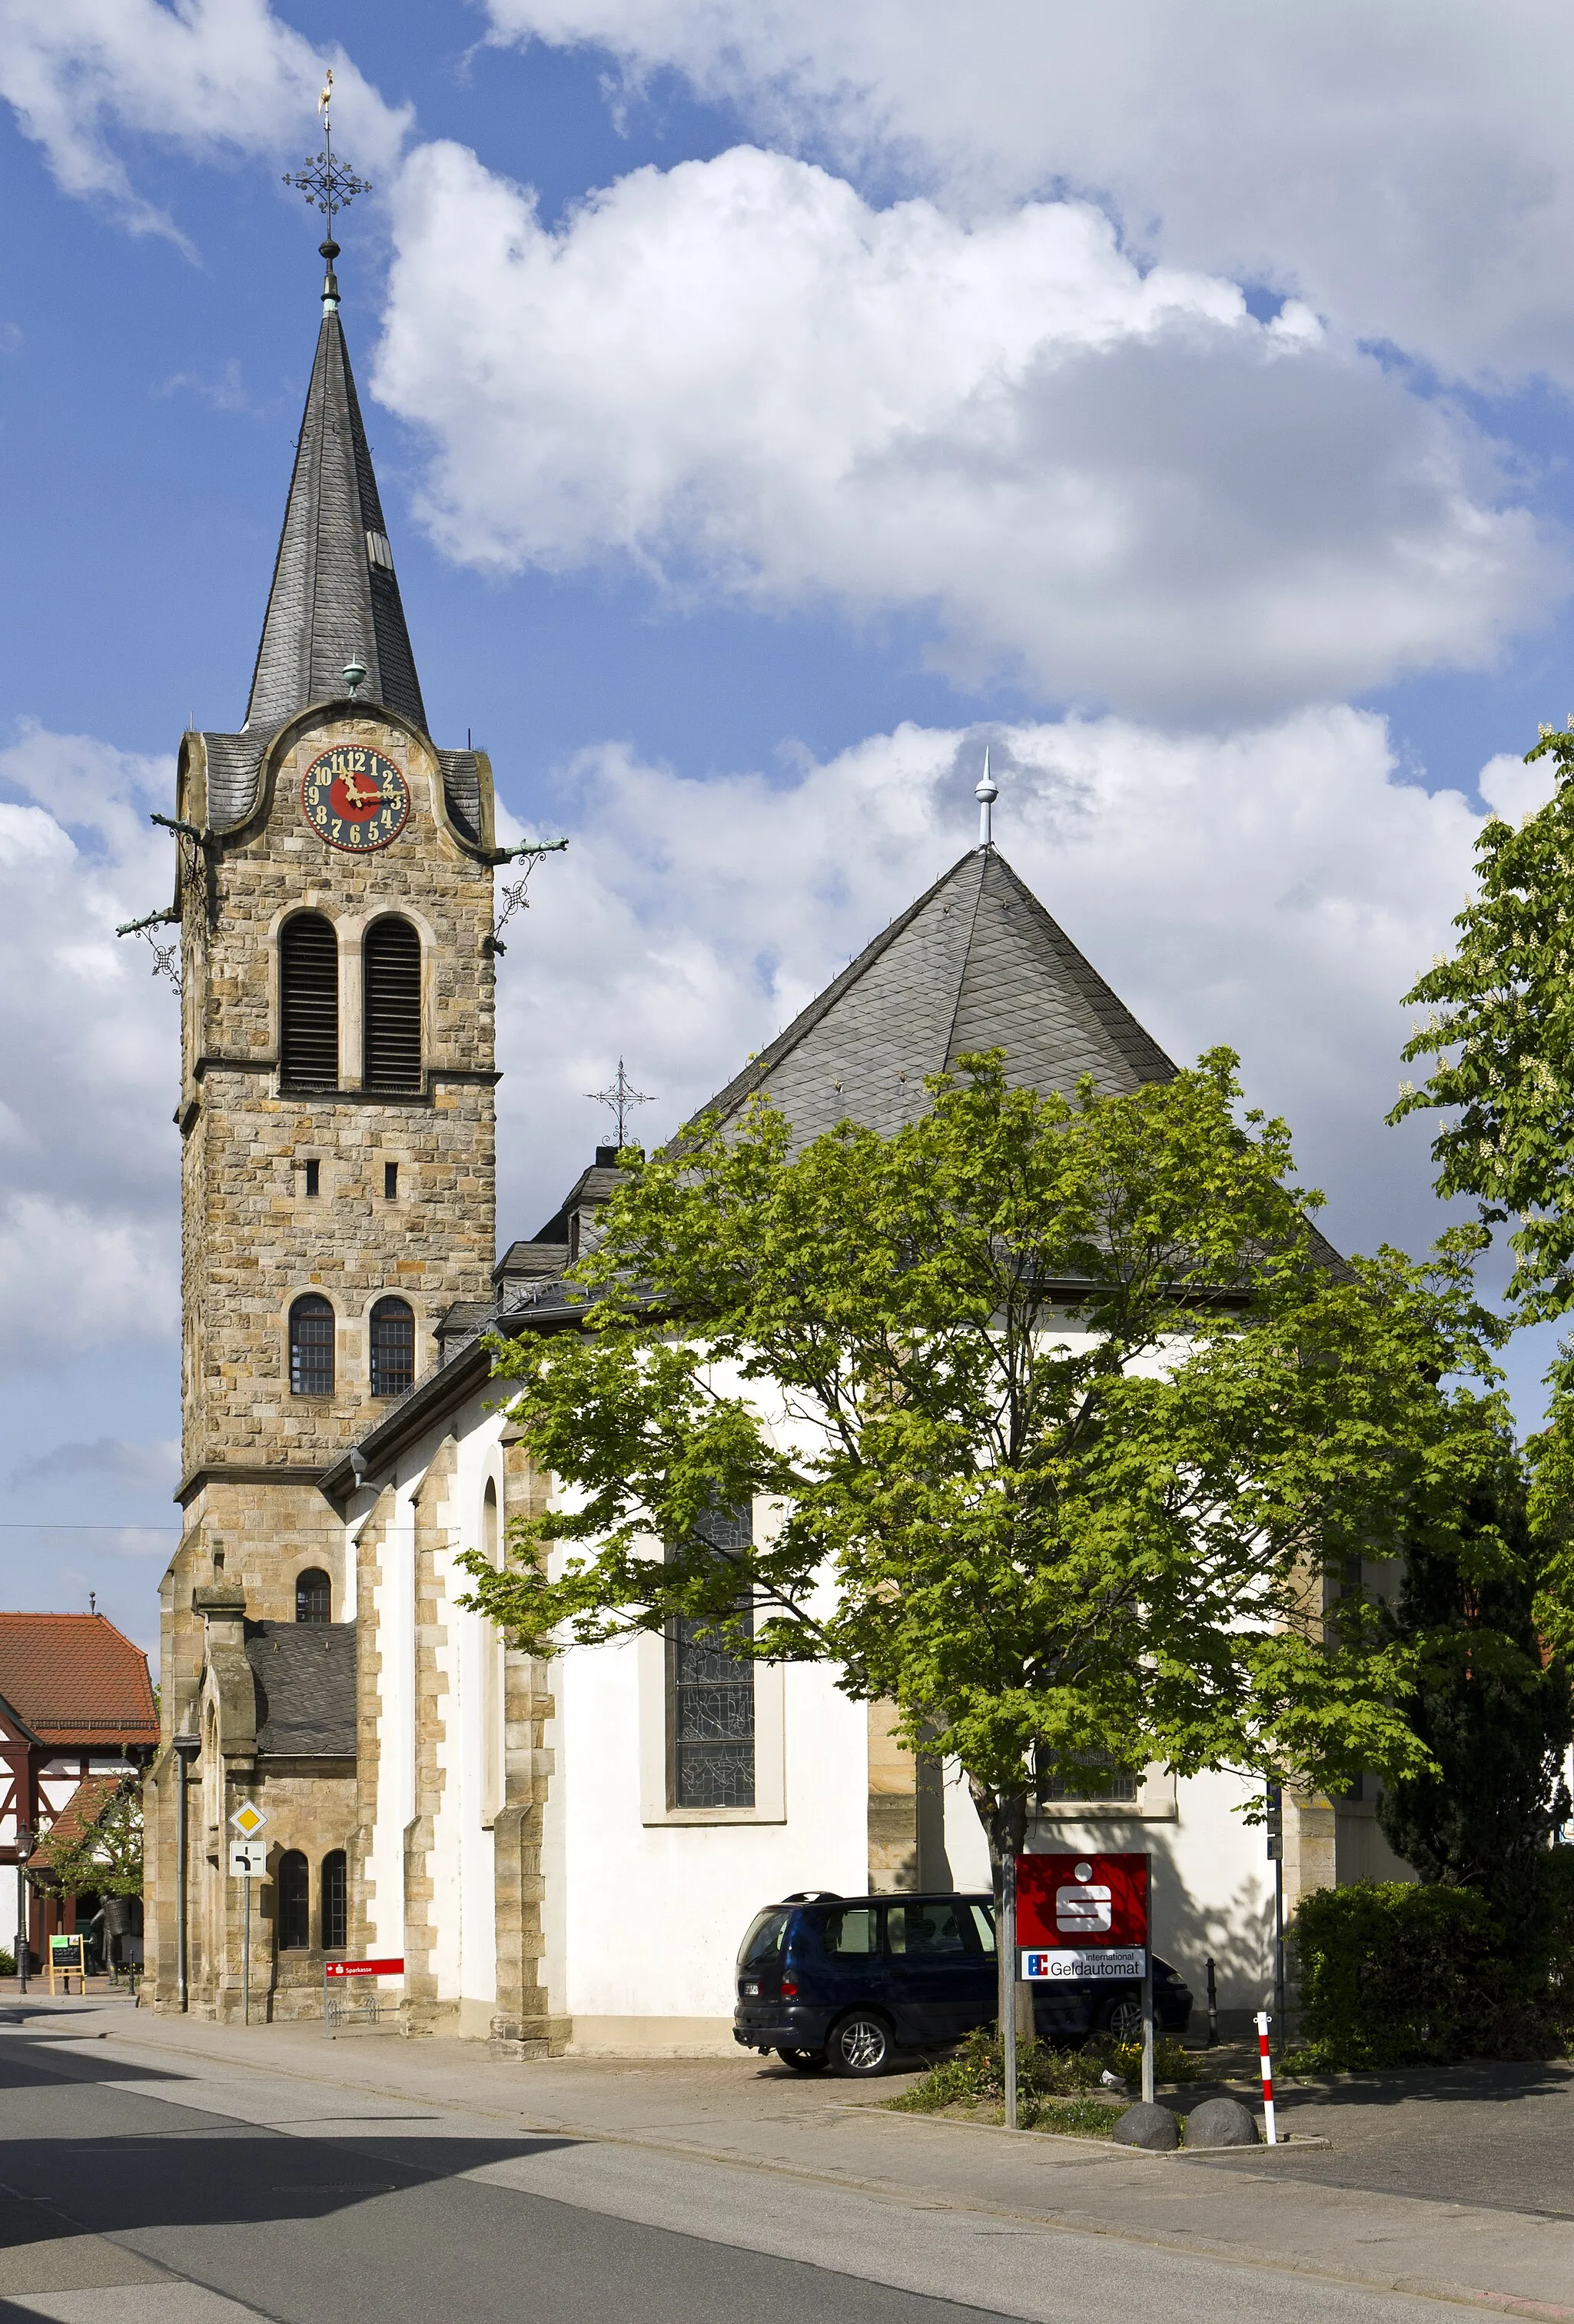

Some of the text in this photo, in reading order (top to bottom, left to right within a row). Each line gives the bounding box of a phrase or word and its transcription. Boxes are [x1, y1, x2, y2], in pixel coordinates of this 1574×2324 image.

[330, 754, 344, 773] 11
[347, 751, 366, 771] 12
[370, 756, 378, 776] 1
[314, 766, 332, 786] 10
[382, 770, 394, 789] 2
[308, 786, 319, 805] 9
[316, 806, 327, 825] 8
[380, 810, 393, 829] 4
[331, 819, 342, 838] 7
[350, 825, 360, 843] 6
[368, 821, 379, 840] 5
[1086, 1953, 1134, 1961] international
[1051, 1962, 1139, 1976] Geldautomat
